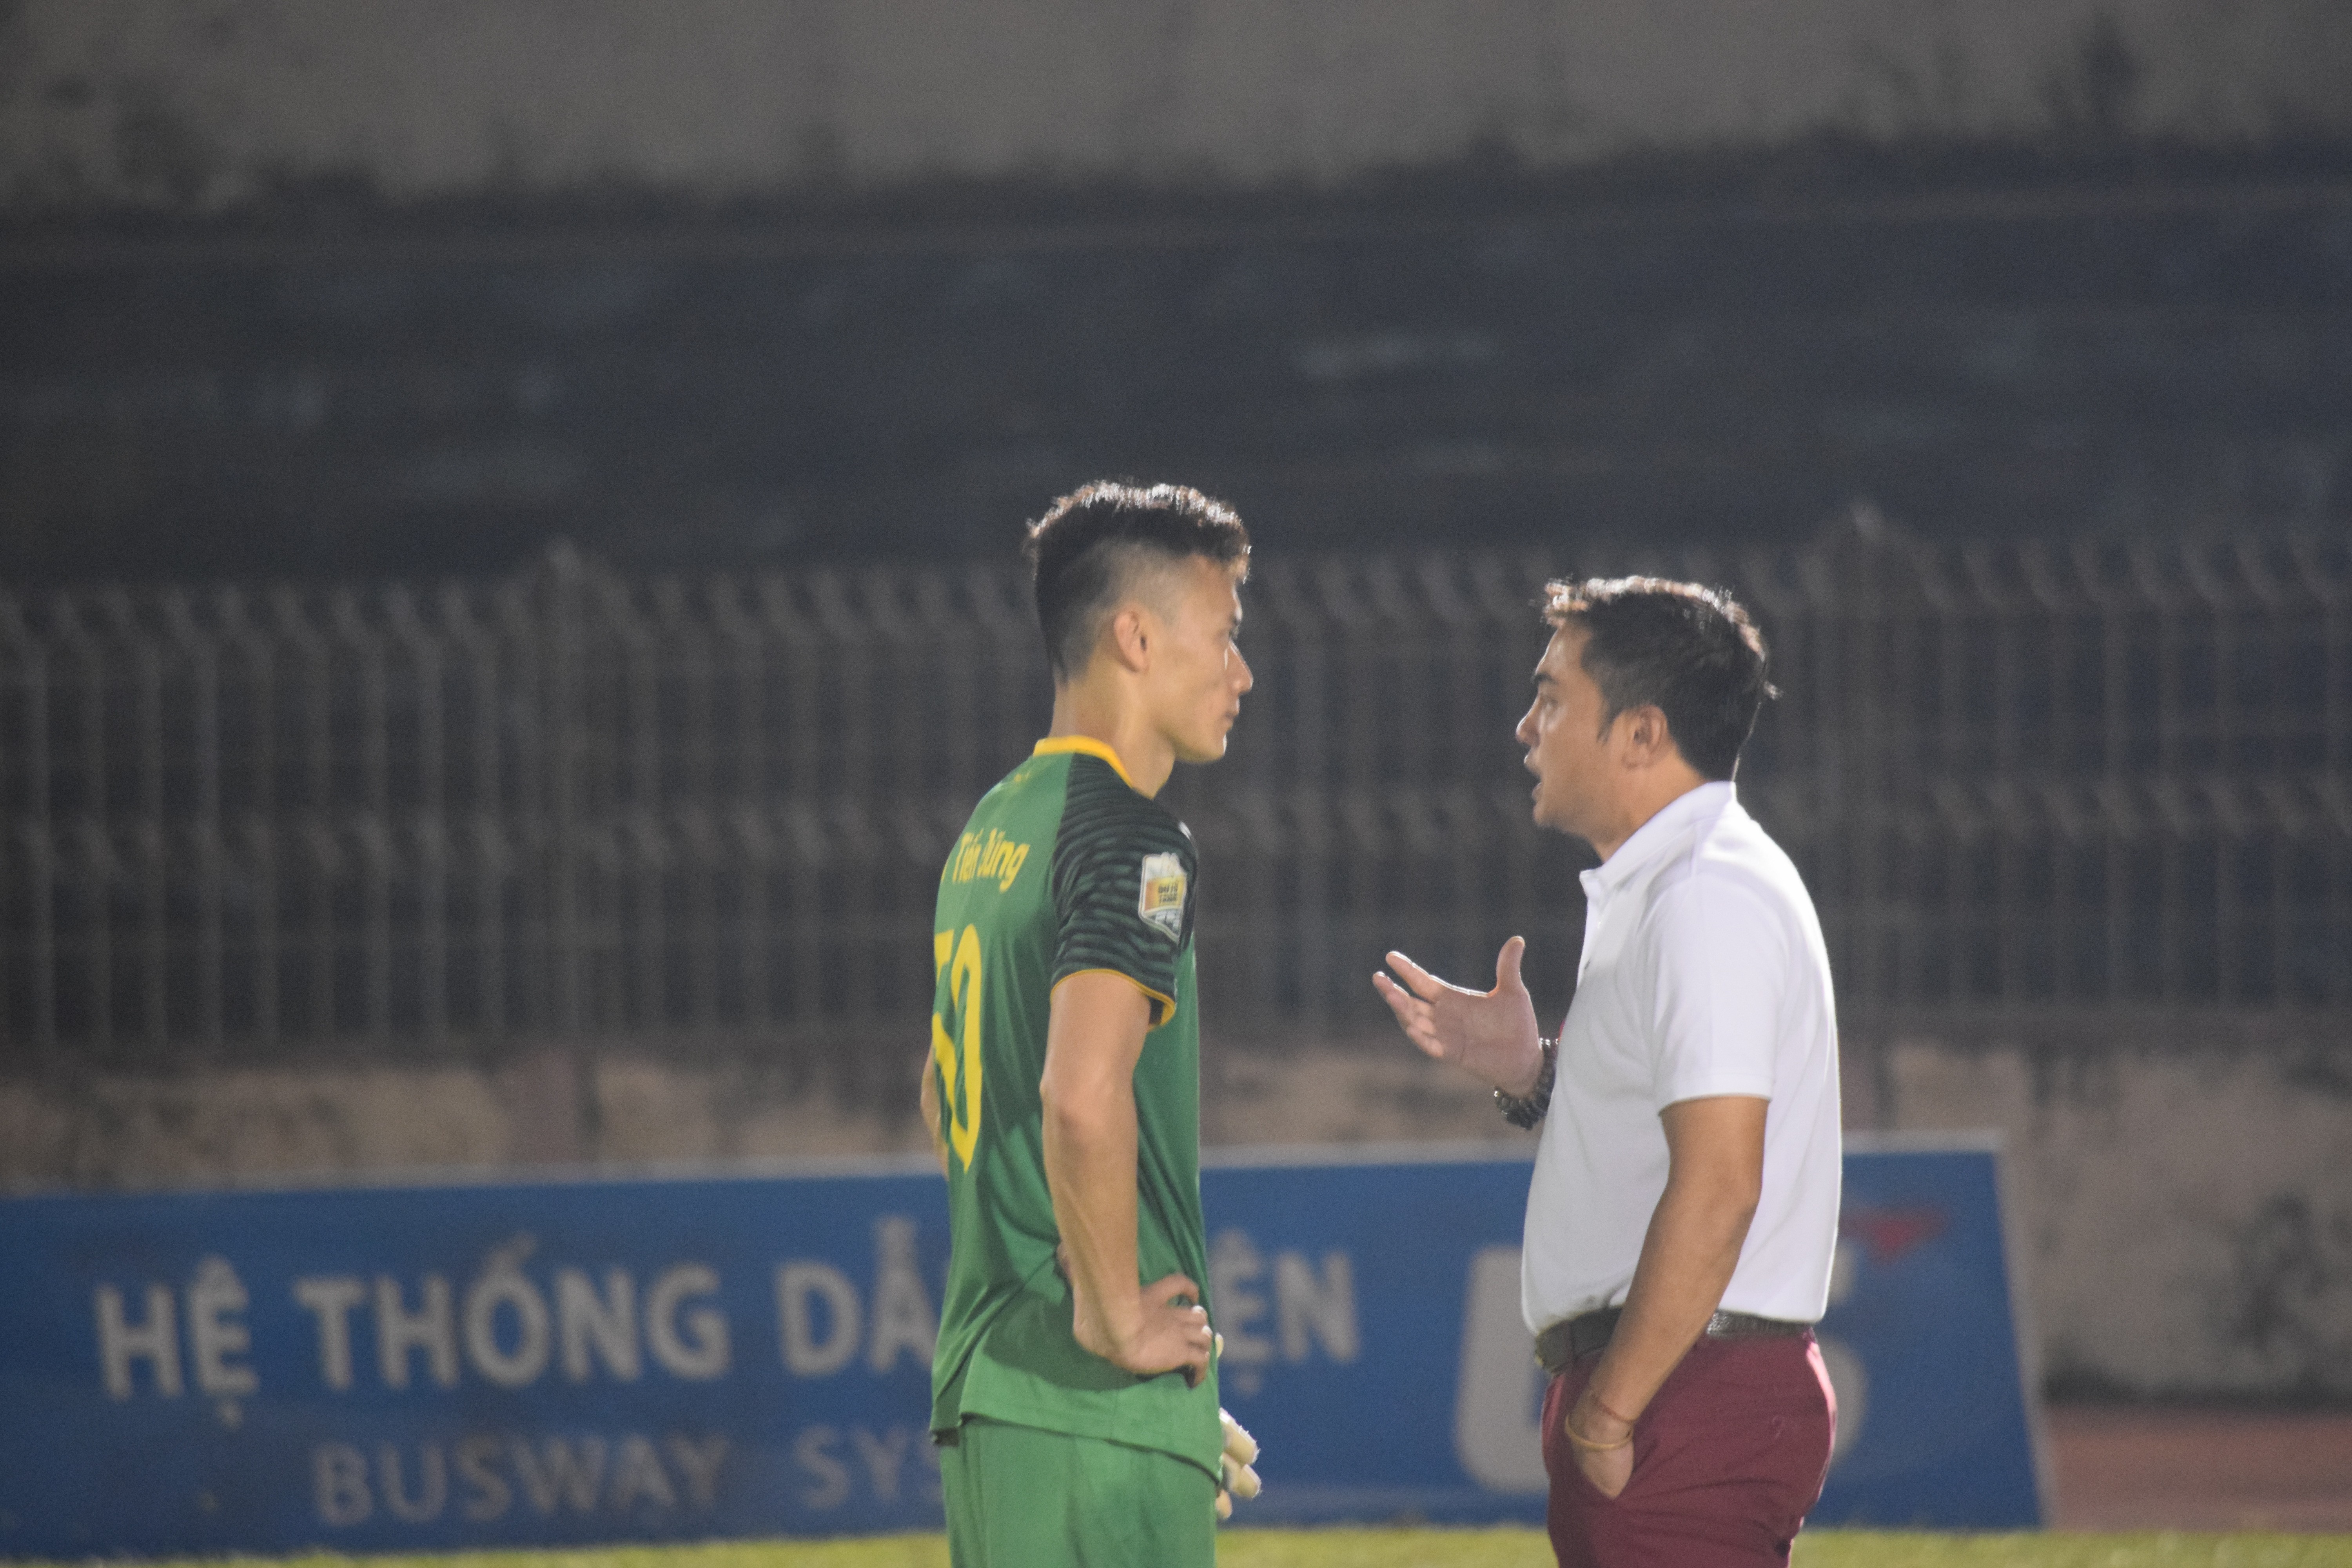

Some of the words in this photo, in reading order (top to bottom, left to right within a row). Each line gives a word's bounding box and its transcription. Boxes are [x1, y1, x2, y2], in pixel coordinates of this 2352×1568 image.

[95, 1256, 259, 1427] HỆ
[293, 1233, 731, 1388] THỐNG
[314, 1432, 730, 1525] BUSWAY
